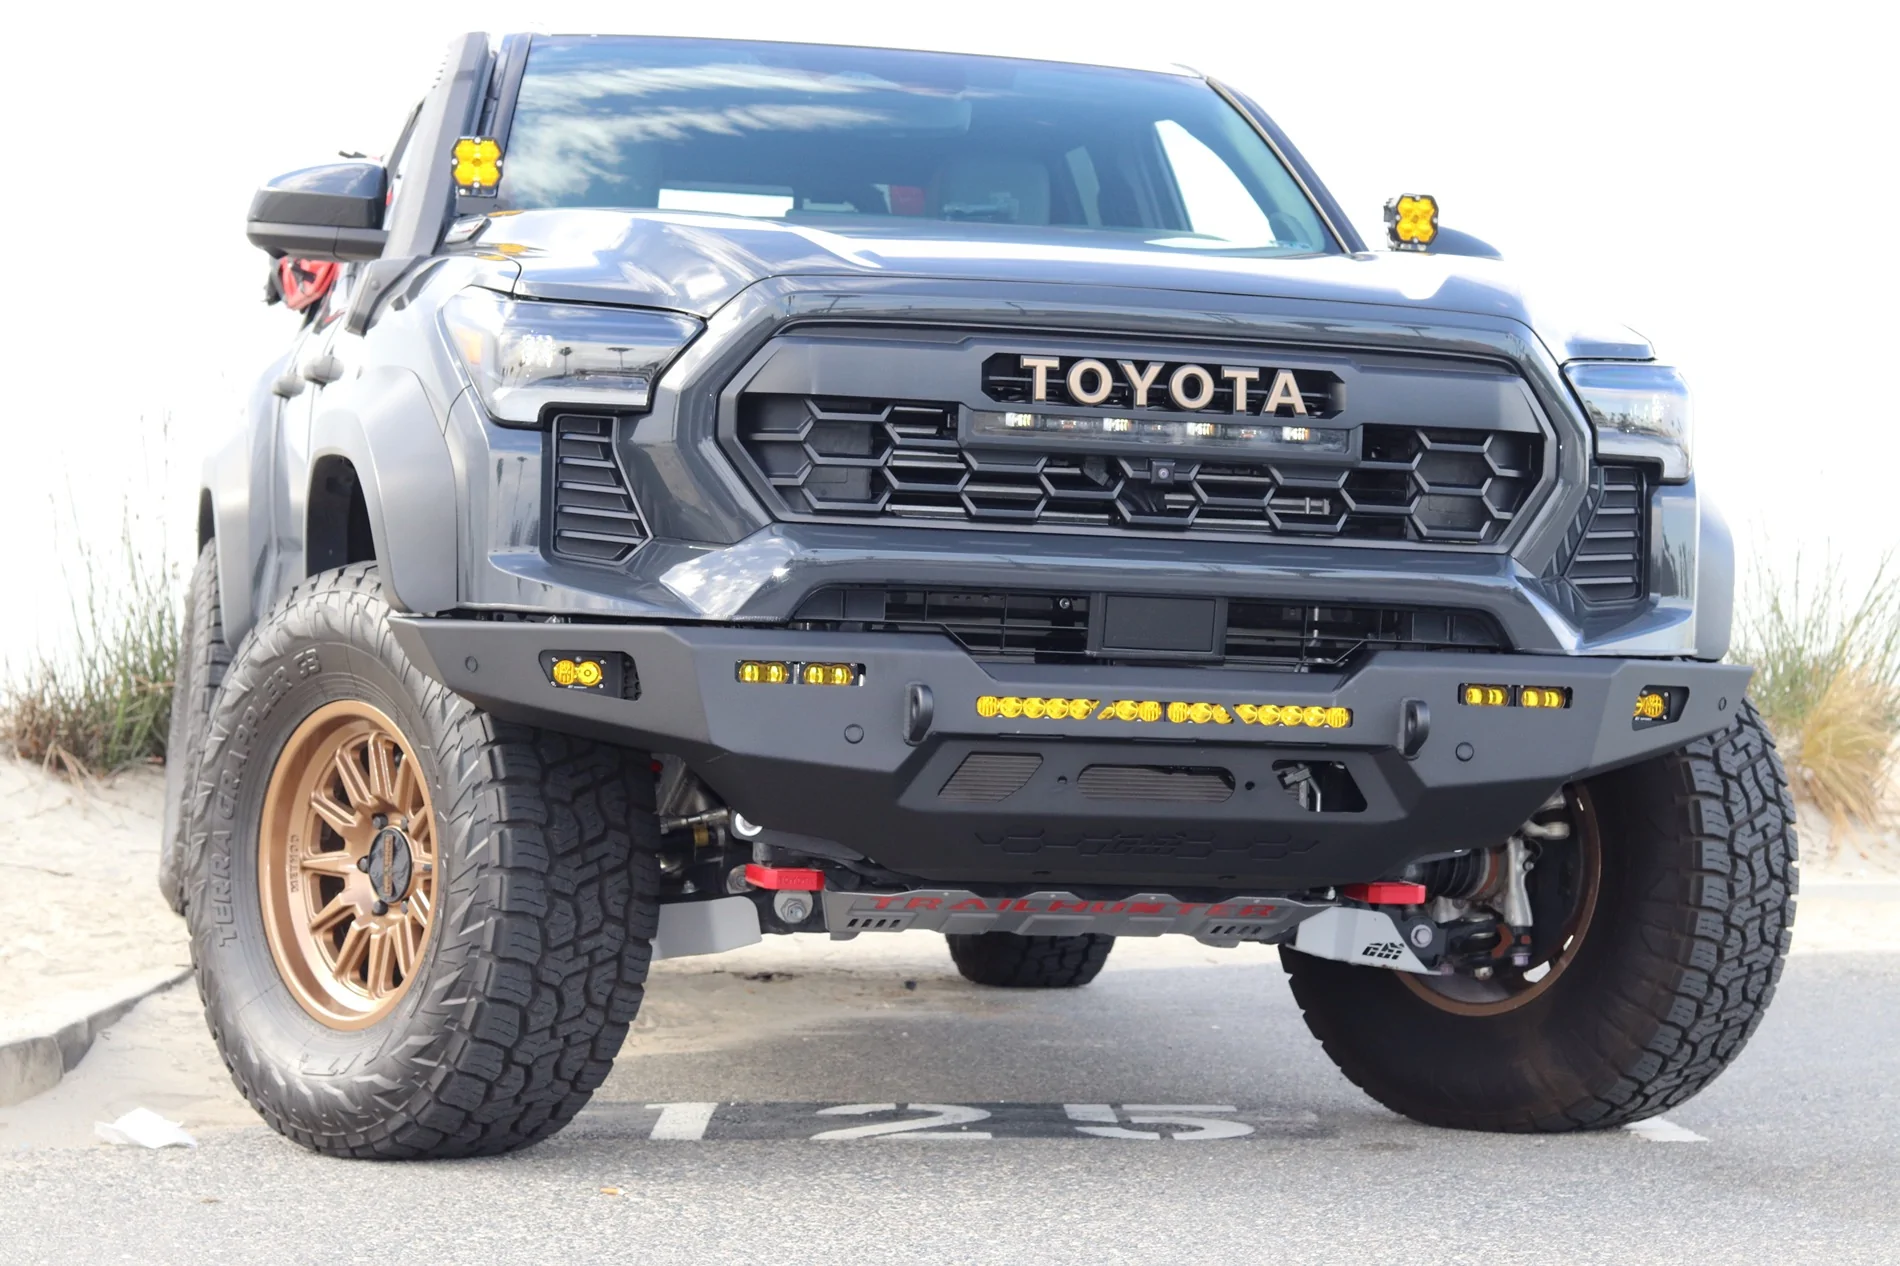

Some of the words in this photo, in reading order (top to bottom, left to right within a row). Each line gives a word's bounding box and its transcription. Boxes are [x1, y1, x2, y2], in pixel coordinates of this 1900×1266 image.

[1020, 356, 1308, 416] TOYOTA
[217, 665, 293, 820] GRAPPLER
[210, 830, 238, 948] TERRA
[290, 834, 301, 894] METHOD
[870, 895, 1276, 918] TRAILHUNTER
